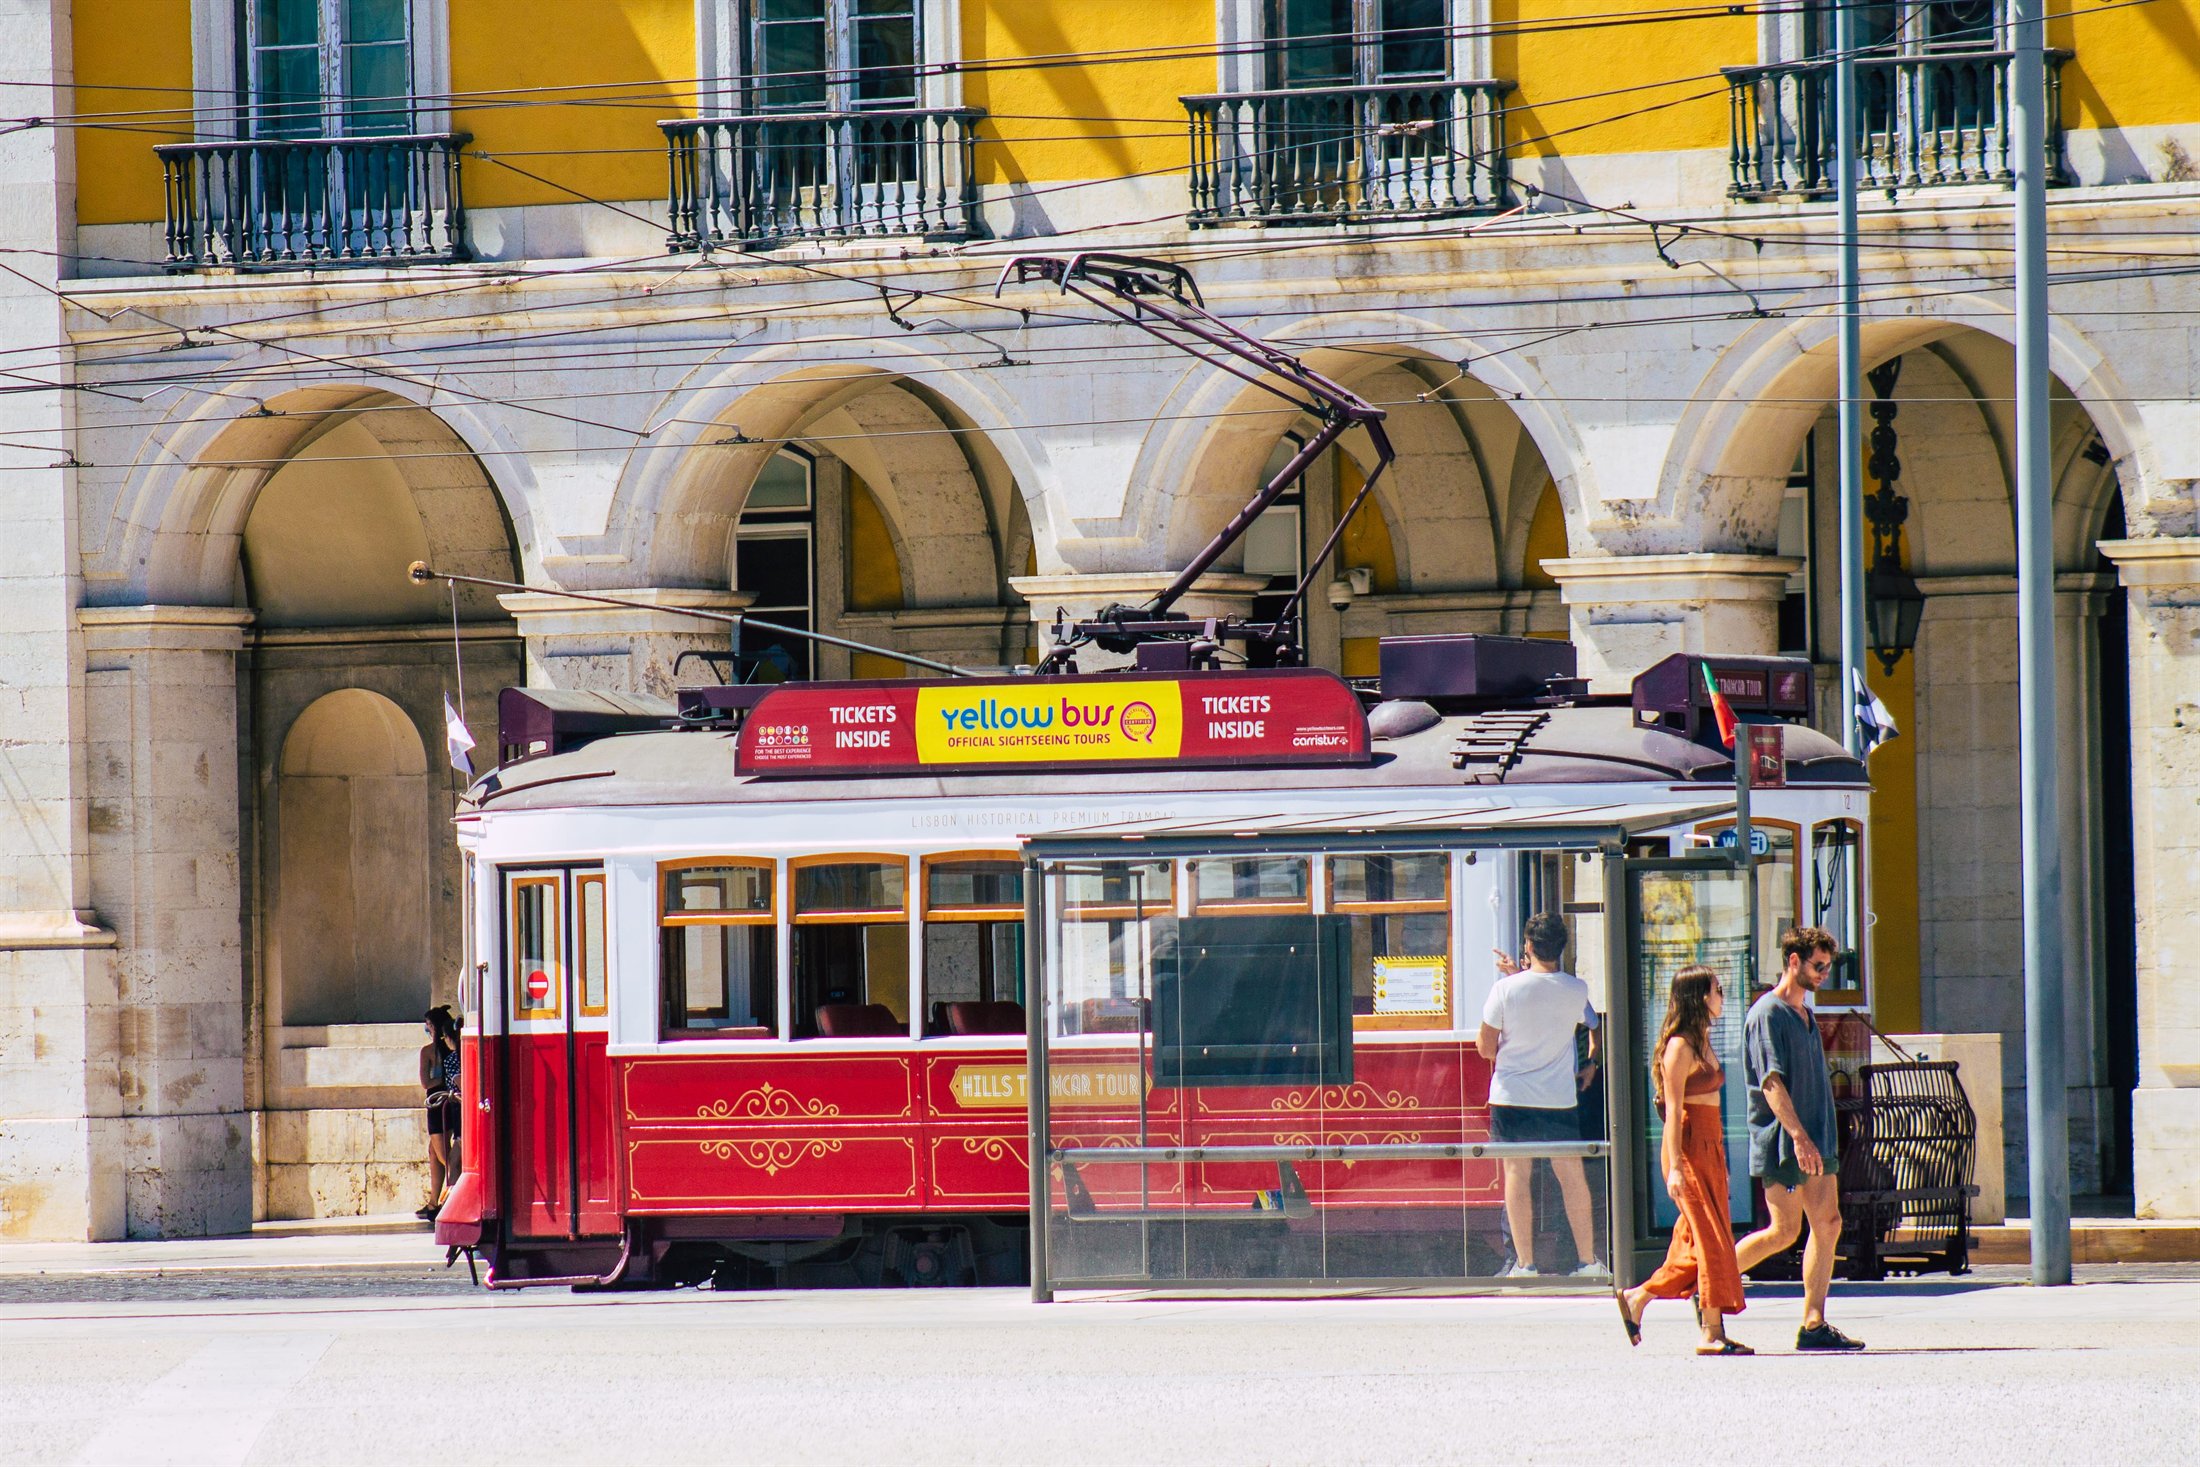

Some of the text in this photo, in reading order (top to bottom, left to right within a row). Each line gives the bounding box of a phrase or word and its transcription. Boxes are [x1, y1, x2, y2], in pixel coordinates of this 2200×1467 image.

[1747, 680, 1762, 697] TOUR
[1061, 697, 1114, 727] bus
[1201, 695, 1271, 715] TICKETS
[829, 705, 897, 724] TICKETS
[1208, 720, 1265, 739] INSIDE
[835, 730, 891, 748] INSIDE
[948, 733, 1111, 748] OFFICIAL SIGHTSEEING TOURS
[1292, 734, 1340, 746] carristur
[911, 815, 957, 828] LISBON
[967, 812, 1042, 826] HISTORICAL
[1053, 811, 1110, 824] PREMIUM
[962, 1073, 1141, 1097] HILLS TMCAR TOUR
